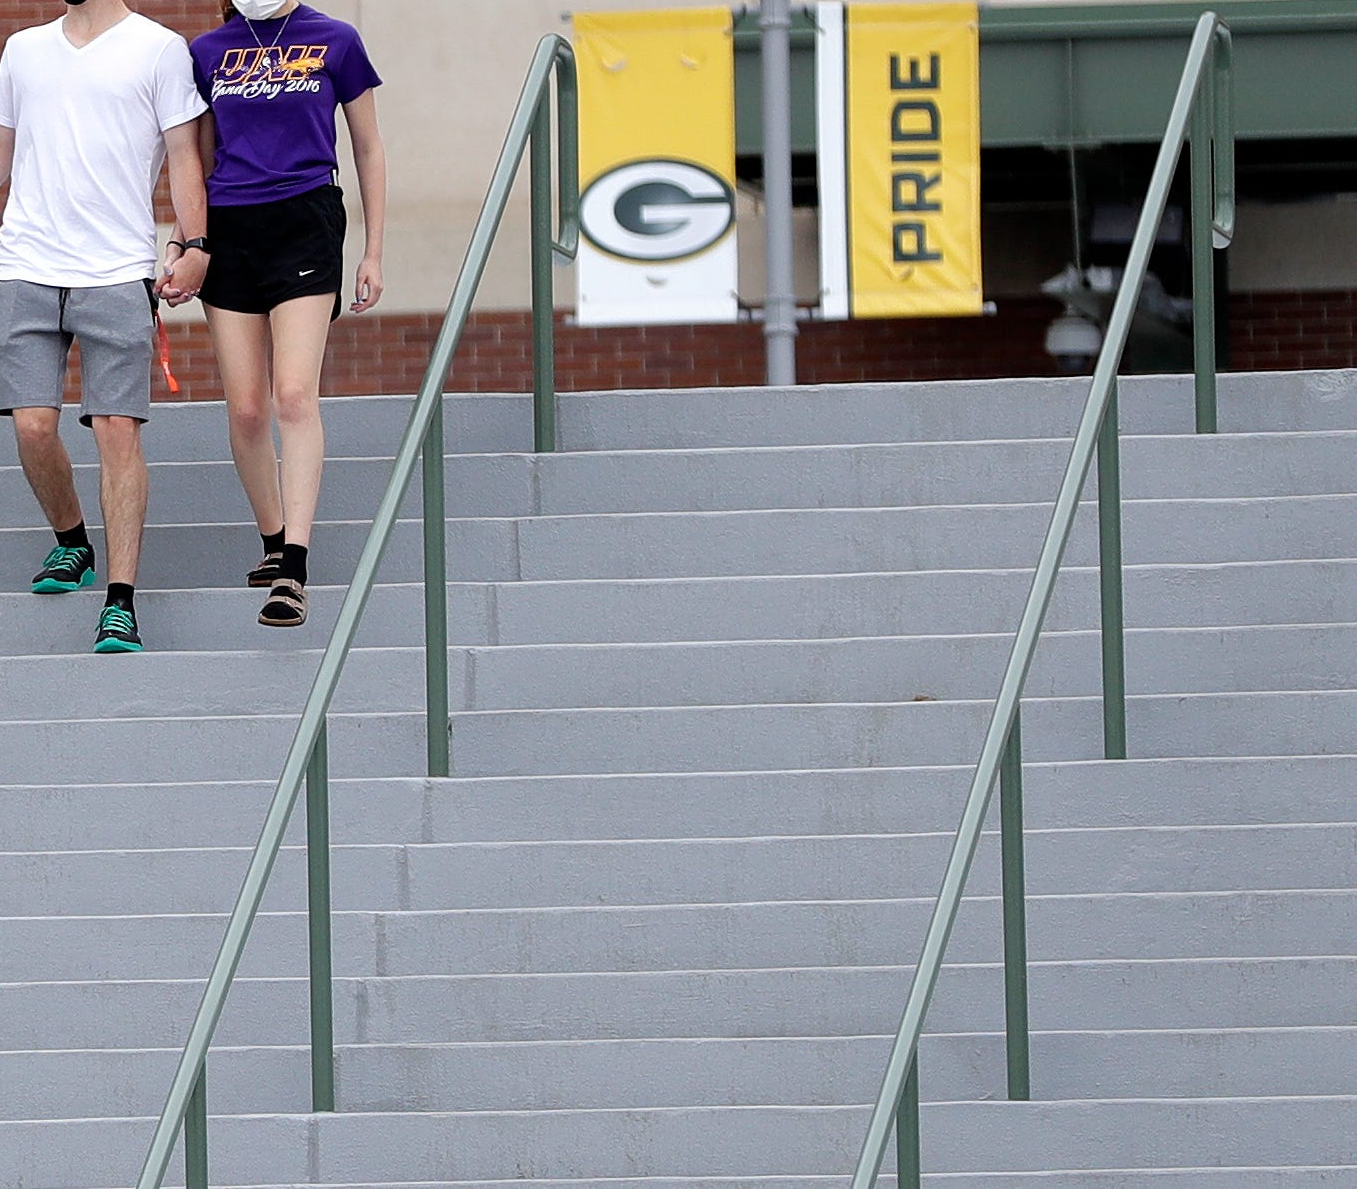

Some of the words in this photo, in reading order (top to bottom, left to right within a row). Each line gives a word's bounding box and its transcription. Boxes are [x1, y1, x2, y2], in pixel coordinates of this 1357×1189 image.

[243, 79, 285, 101] Day
[284, 79, 321, 93] 2016
[889, 53, 945, 264] PRIDE
[580, 161, 732, 261] G
